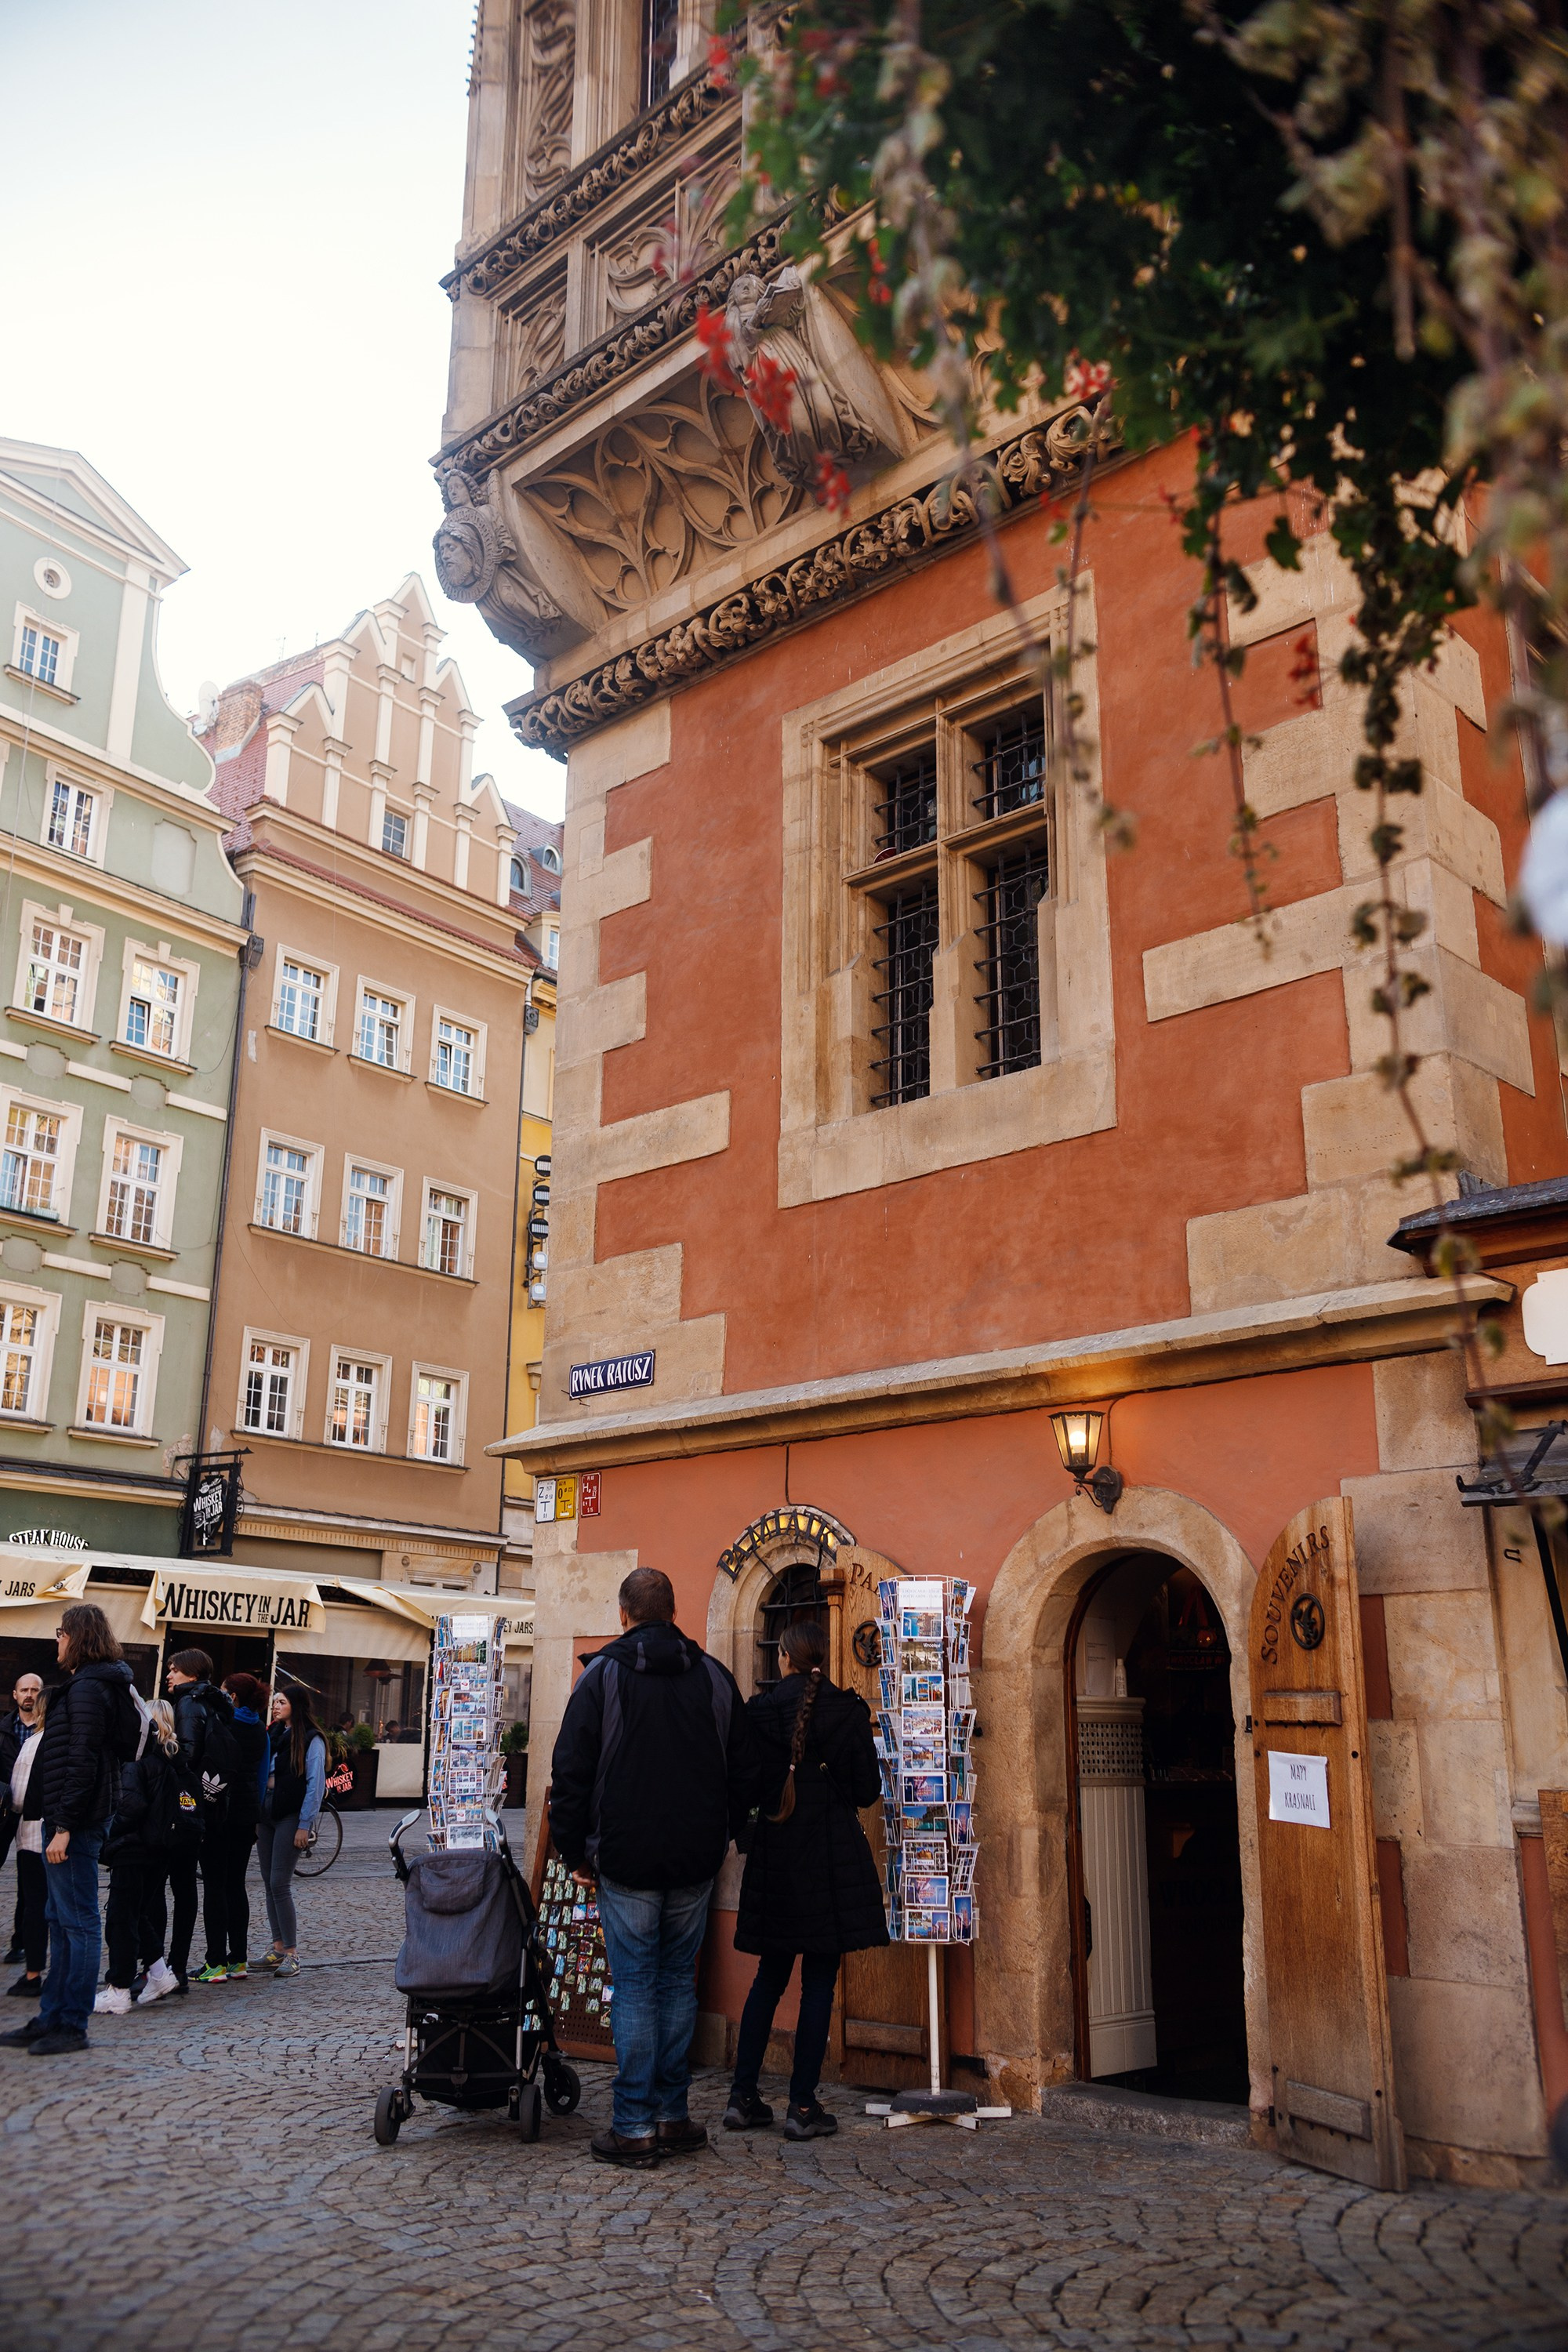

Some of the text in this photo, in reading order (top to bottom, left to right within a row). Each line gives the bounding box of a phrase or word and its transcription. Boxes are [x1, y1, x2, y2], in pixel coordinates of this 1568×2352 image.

[572, 1356, 652, 1393] RYNEK RATUSZ
[193, 1490, 223, 1513] WHISKEY
[211, 1501, 223, 1517] JAR
[9, 1529, 90, 1550] STEAK HOUSE
[5, 1581, 36, 1597] JARS
[1261, 1525, 1330, 1665] SOUVENIRS
[158, 1583, 311, 1628] WHISKEY IN JAR
[257, 1613, 269, 1624] THE
[514, 1621, 533, 1635] JARS
[325, 1771, 353, 1788] WHISKEY
[1290, 1764, 1307, 1781] MAPY
[342, 1781, 353, 1792] JAR
[1284, 1792, 1316, 1811] KRASNALI
